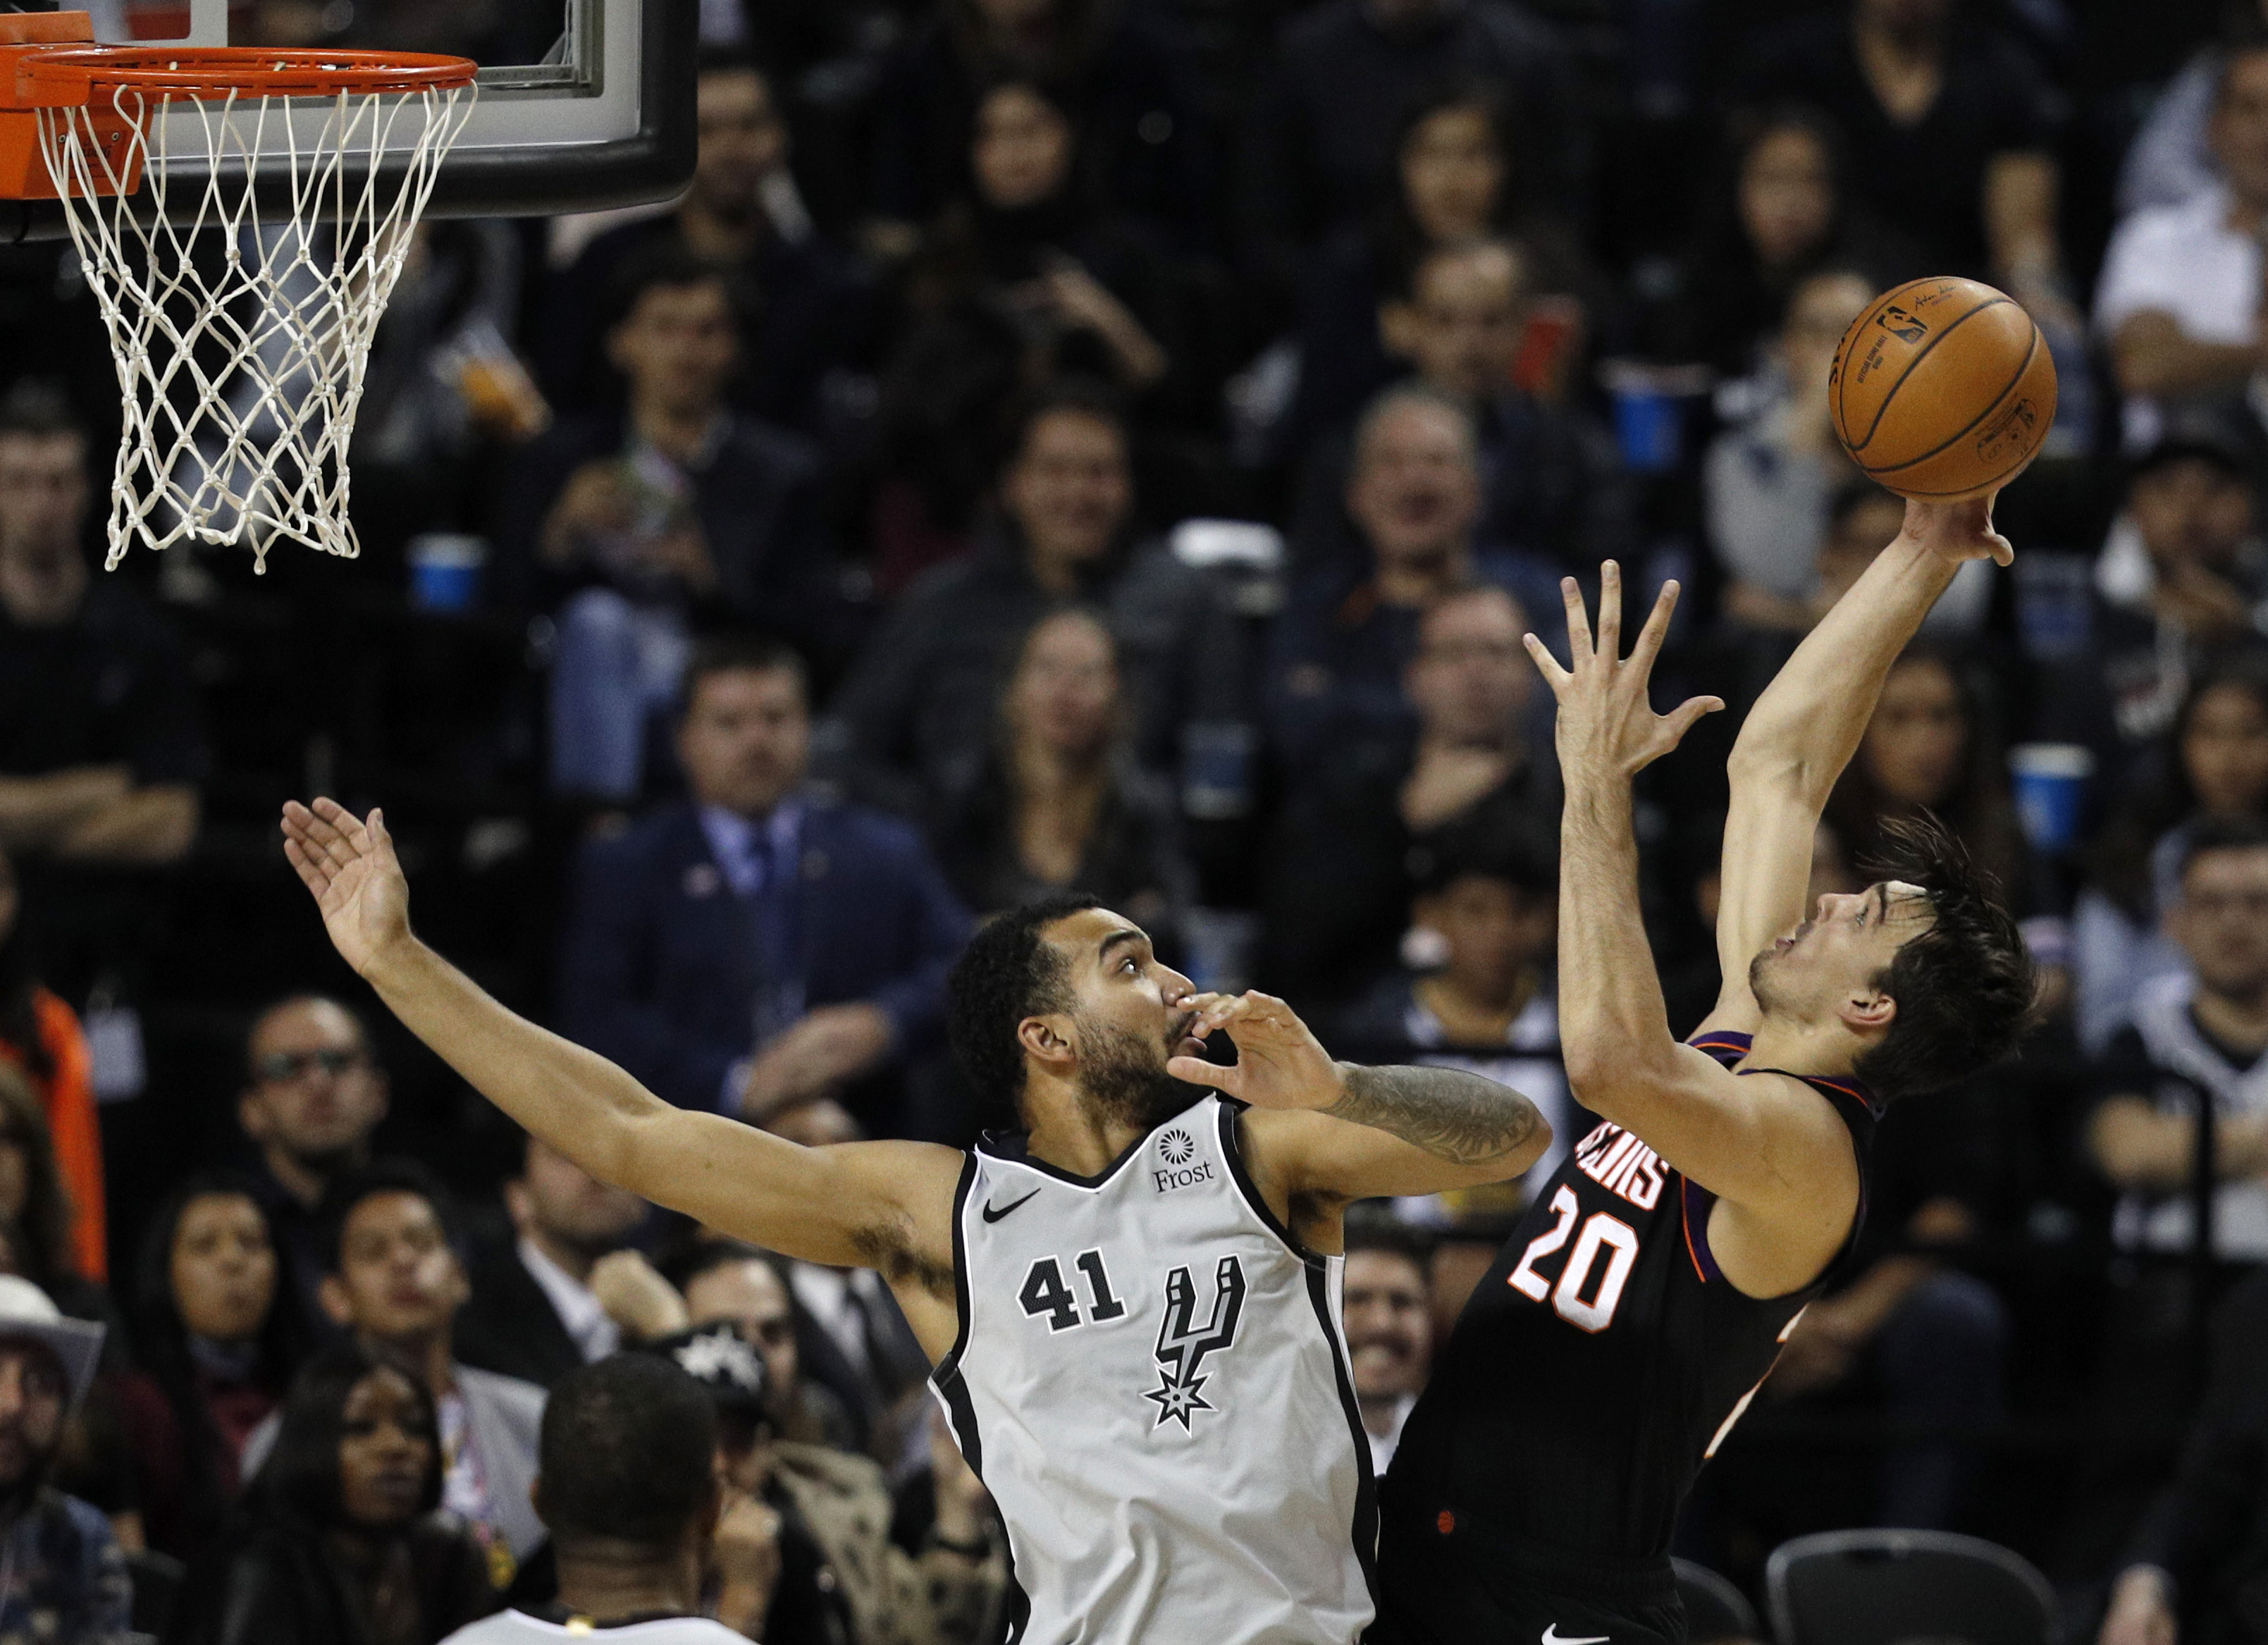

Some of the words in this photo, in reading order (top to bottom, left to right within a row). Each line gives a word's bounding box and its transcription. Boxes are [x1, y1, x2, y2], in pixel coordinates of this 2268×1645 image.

[1153, 1160, 1214, 1193] Frost
[1016, 1247, 1128, 1335] 41
[1507, 1183, 1640, 1334] 20
